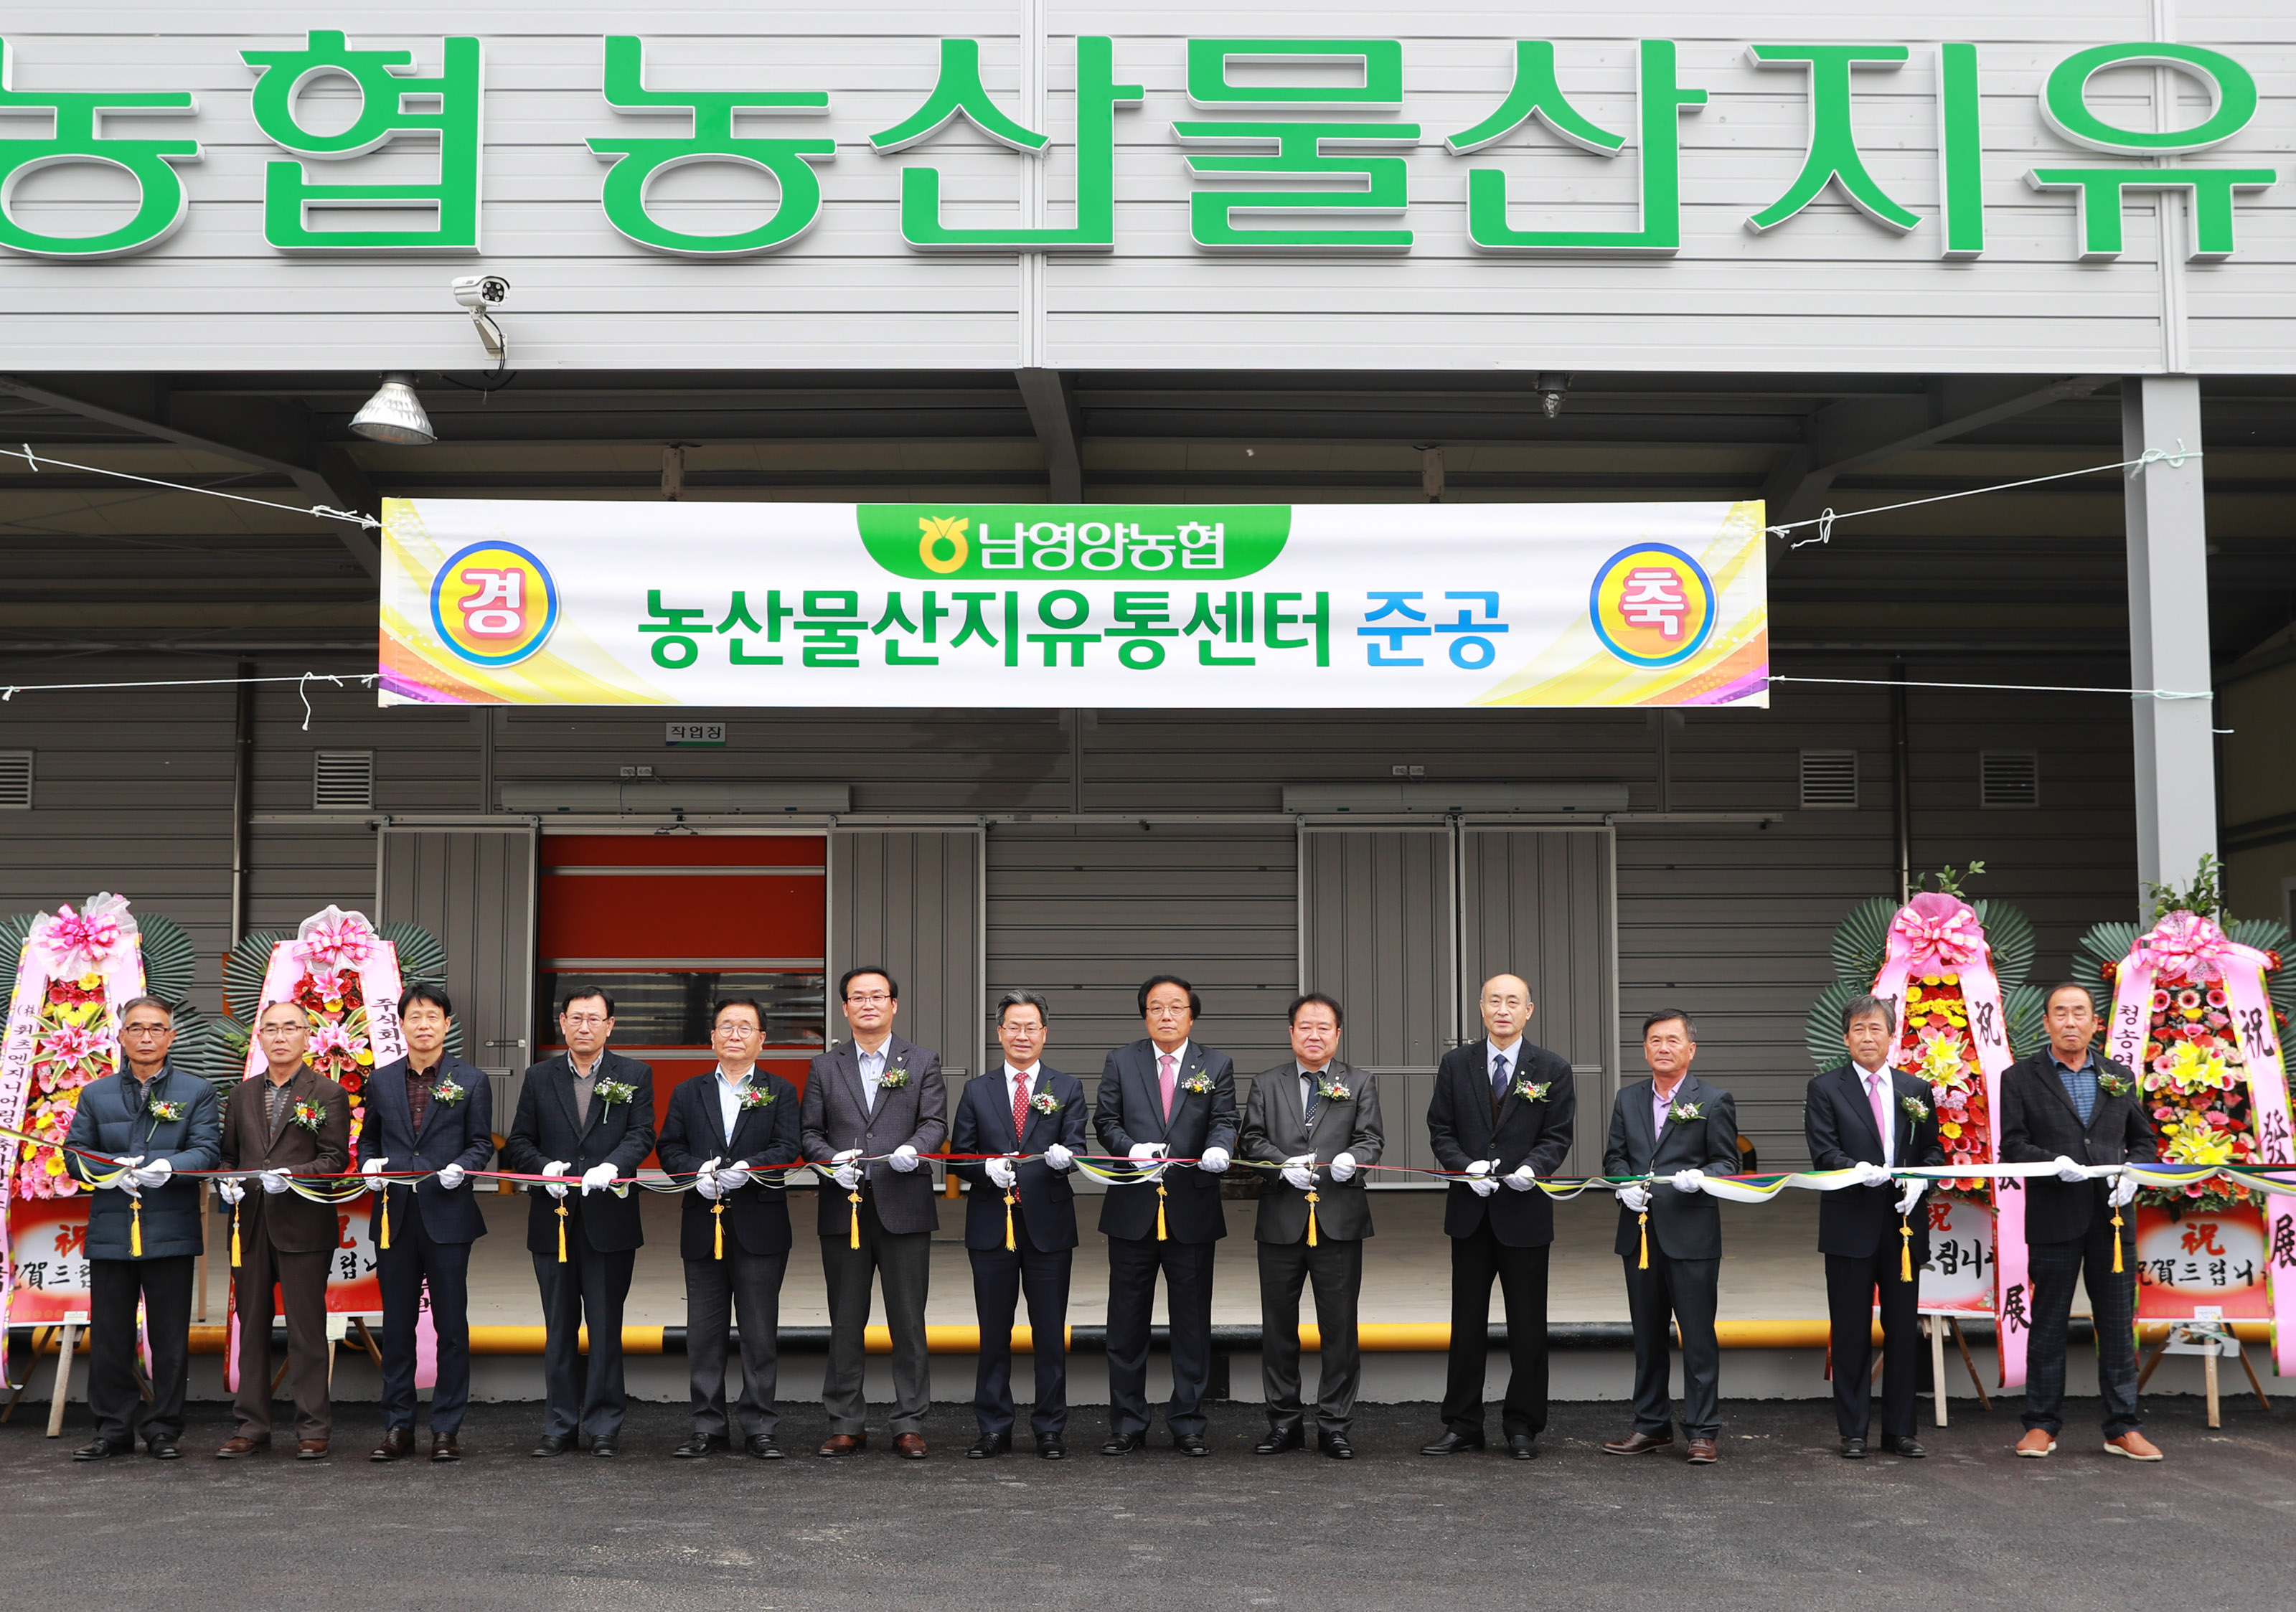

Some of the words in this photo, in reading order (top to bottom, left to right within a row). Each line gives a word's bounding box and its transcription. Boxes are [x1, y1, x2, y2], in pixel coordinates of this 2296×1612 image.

[0, 30, 481, 255] 농협
[584, 34, 2278, 261] 농산물산지유
[979, 521, 1225, 572] 남영양농협
[461, 570, 525, 635] 경
[638, 588, 1330, 671] 농산물산지유통센터
[1356, 590, 1510, 671] 준공
[1622, 570, 1685, 637] 축
[670, 725, 723, 740] 작업장
[371, 998, 408, 1057] 주식회사
[2181, 1222, 2226, 1256] 祝
